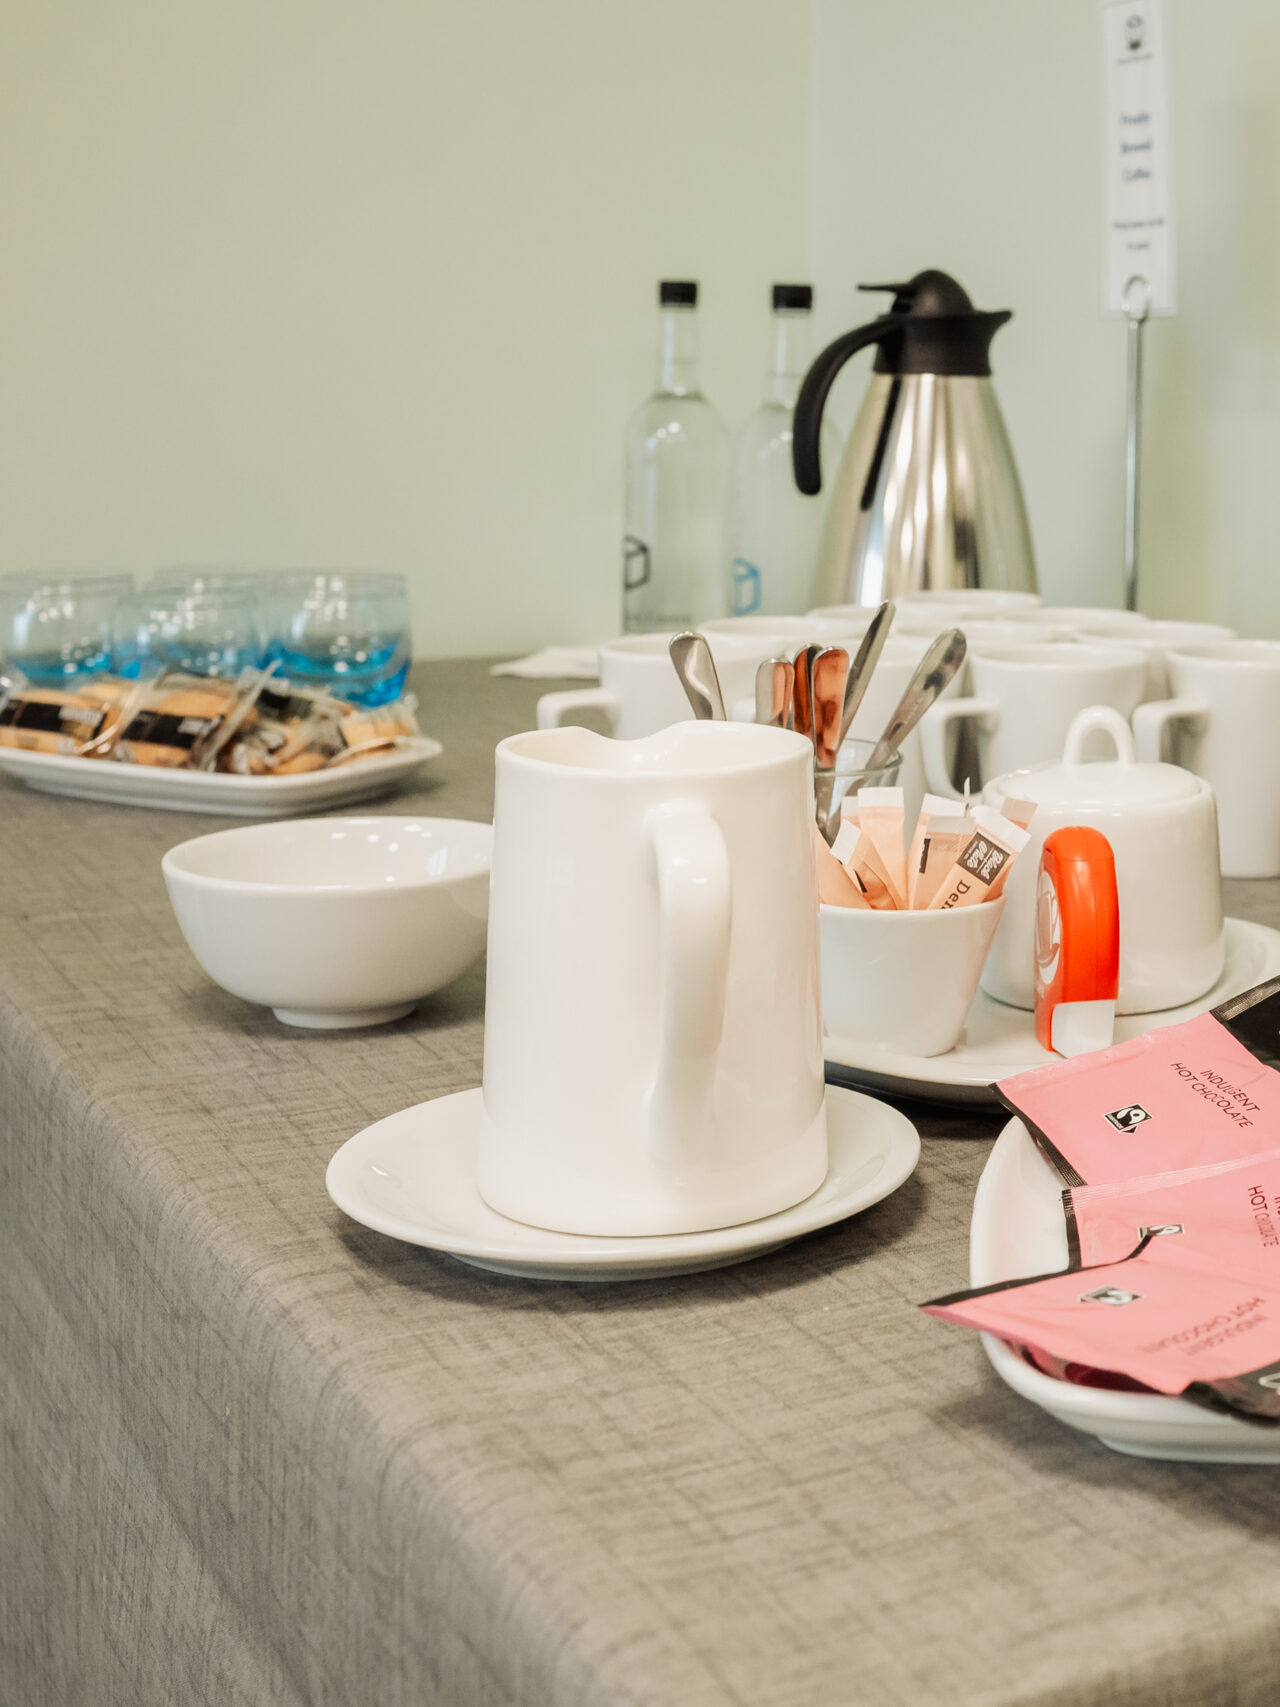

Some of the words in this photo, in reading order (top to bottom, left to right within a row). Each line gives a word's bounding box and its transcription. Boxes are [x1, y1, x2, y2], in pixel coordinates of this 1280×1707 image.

[967, 841, 988, 868] White
[981, 850, 1003, 879] Black
[1170, 1062, 1194, 1083] HOT
[1191, 1082, 1254, 1129] CHOCOLATE
[1200, 1069, 1260, 1113] INDULGENT
[1248, 1184, 1268, 1211] HOT
